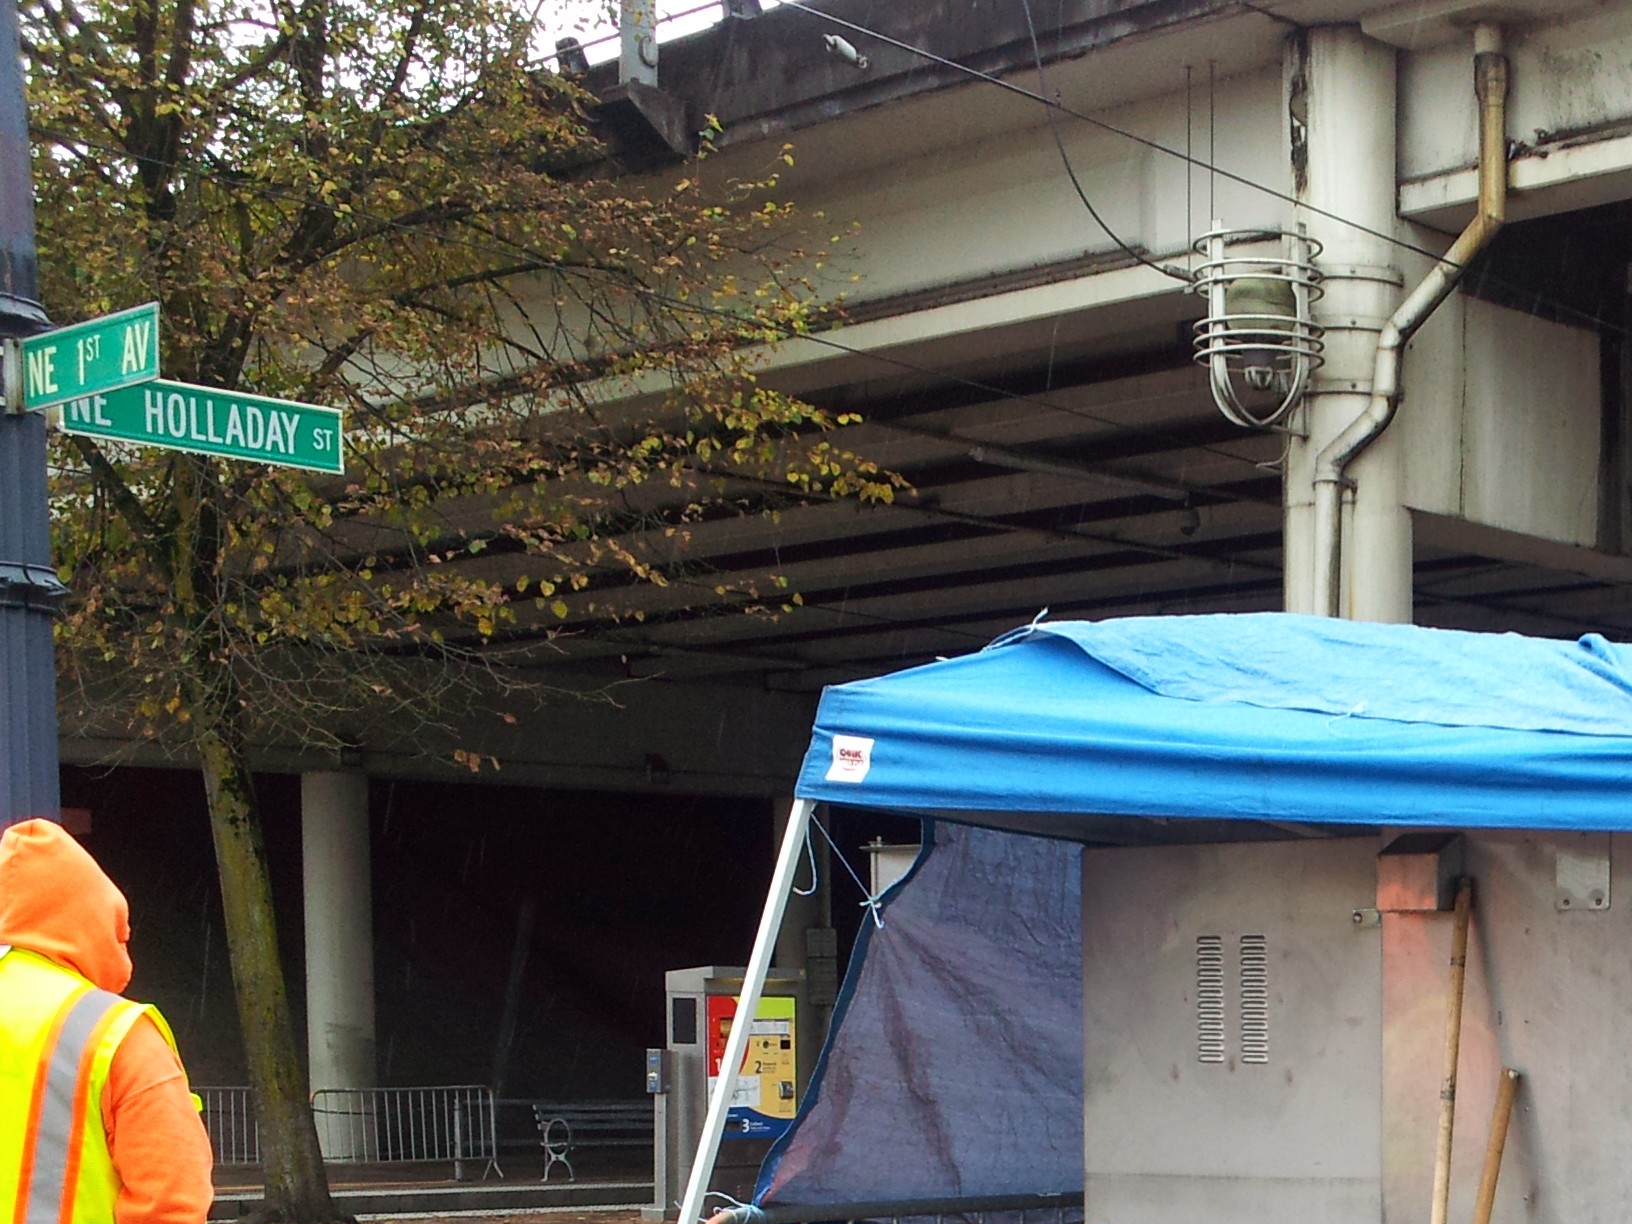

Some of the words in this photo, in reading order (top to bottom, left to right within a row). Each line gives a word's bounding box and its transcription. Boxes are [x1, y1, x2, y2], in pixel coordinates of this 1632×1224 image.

[28, 346, 58, 398] NE
[77, 334, 100, 386] 1ST
[122, 321, 150, 375] AV
[70, 394, 112, 427] NE
[145, 389, 300, 454] HOLLADAY
[312, 427, 333, 451] ST
[754, 1060, 762, 1074] 2
[742, 1118, 750, 1133] 3
